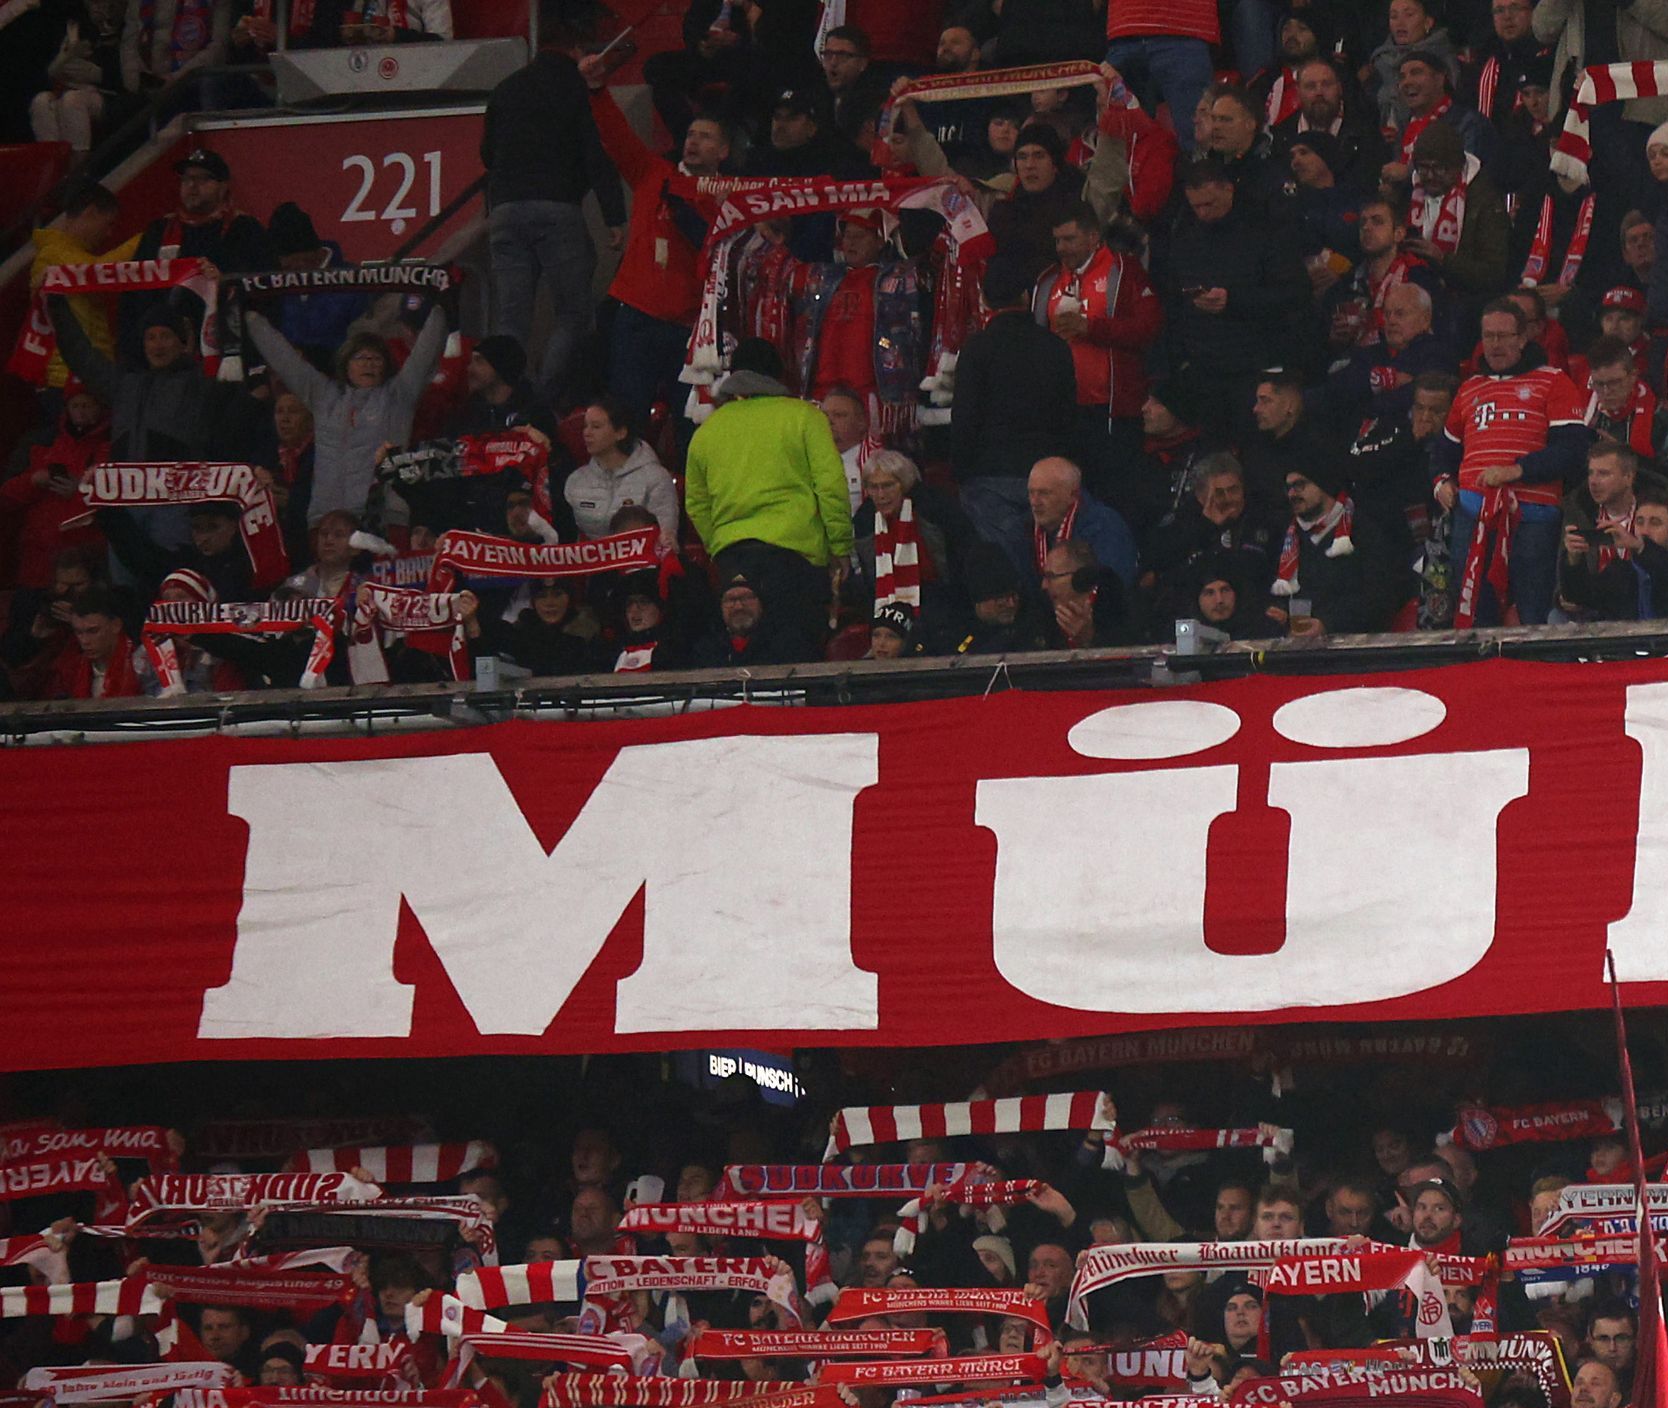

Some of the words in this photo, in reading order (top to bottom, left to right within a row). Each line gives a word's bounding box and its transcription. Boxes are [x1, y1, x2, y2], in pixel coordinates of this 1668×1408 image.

[340, 150, 443, 223] 221
[747, 186, 820, 214] SAN
[828, 180, 895, 211] MIA
[529, 535, 648, 566] MÜNCHEN
